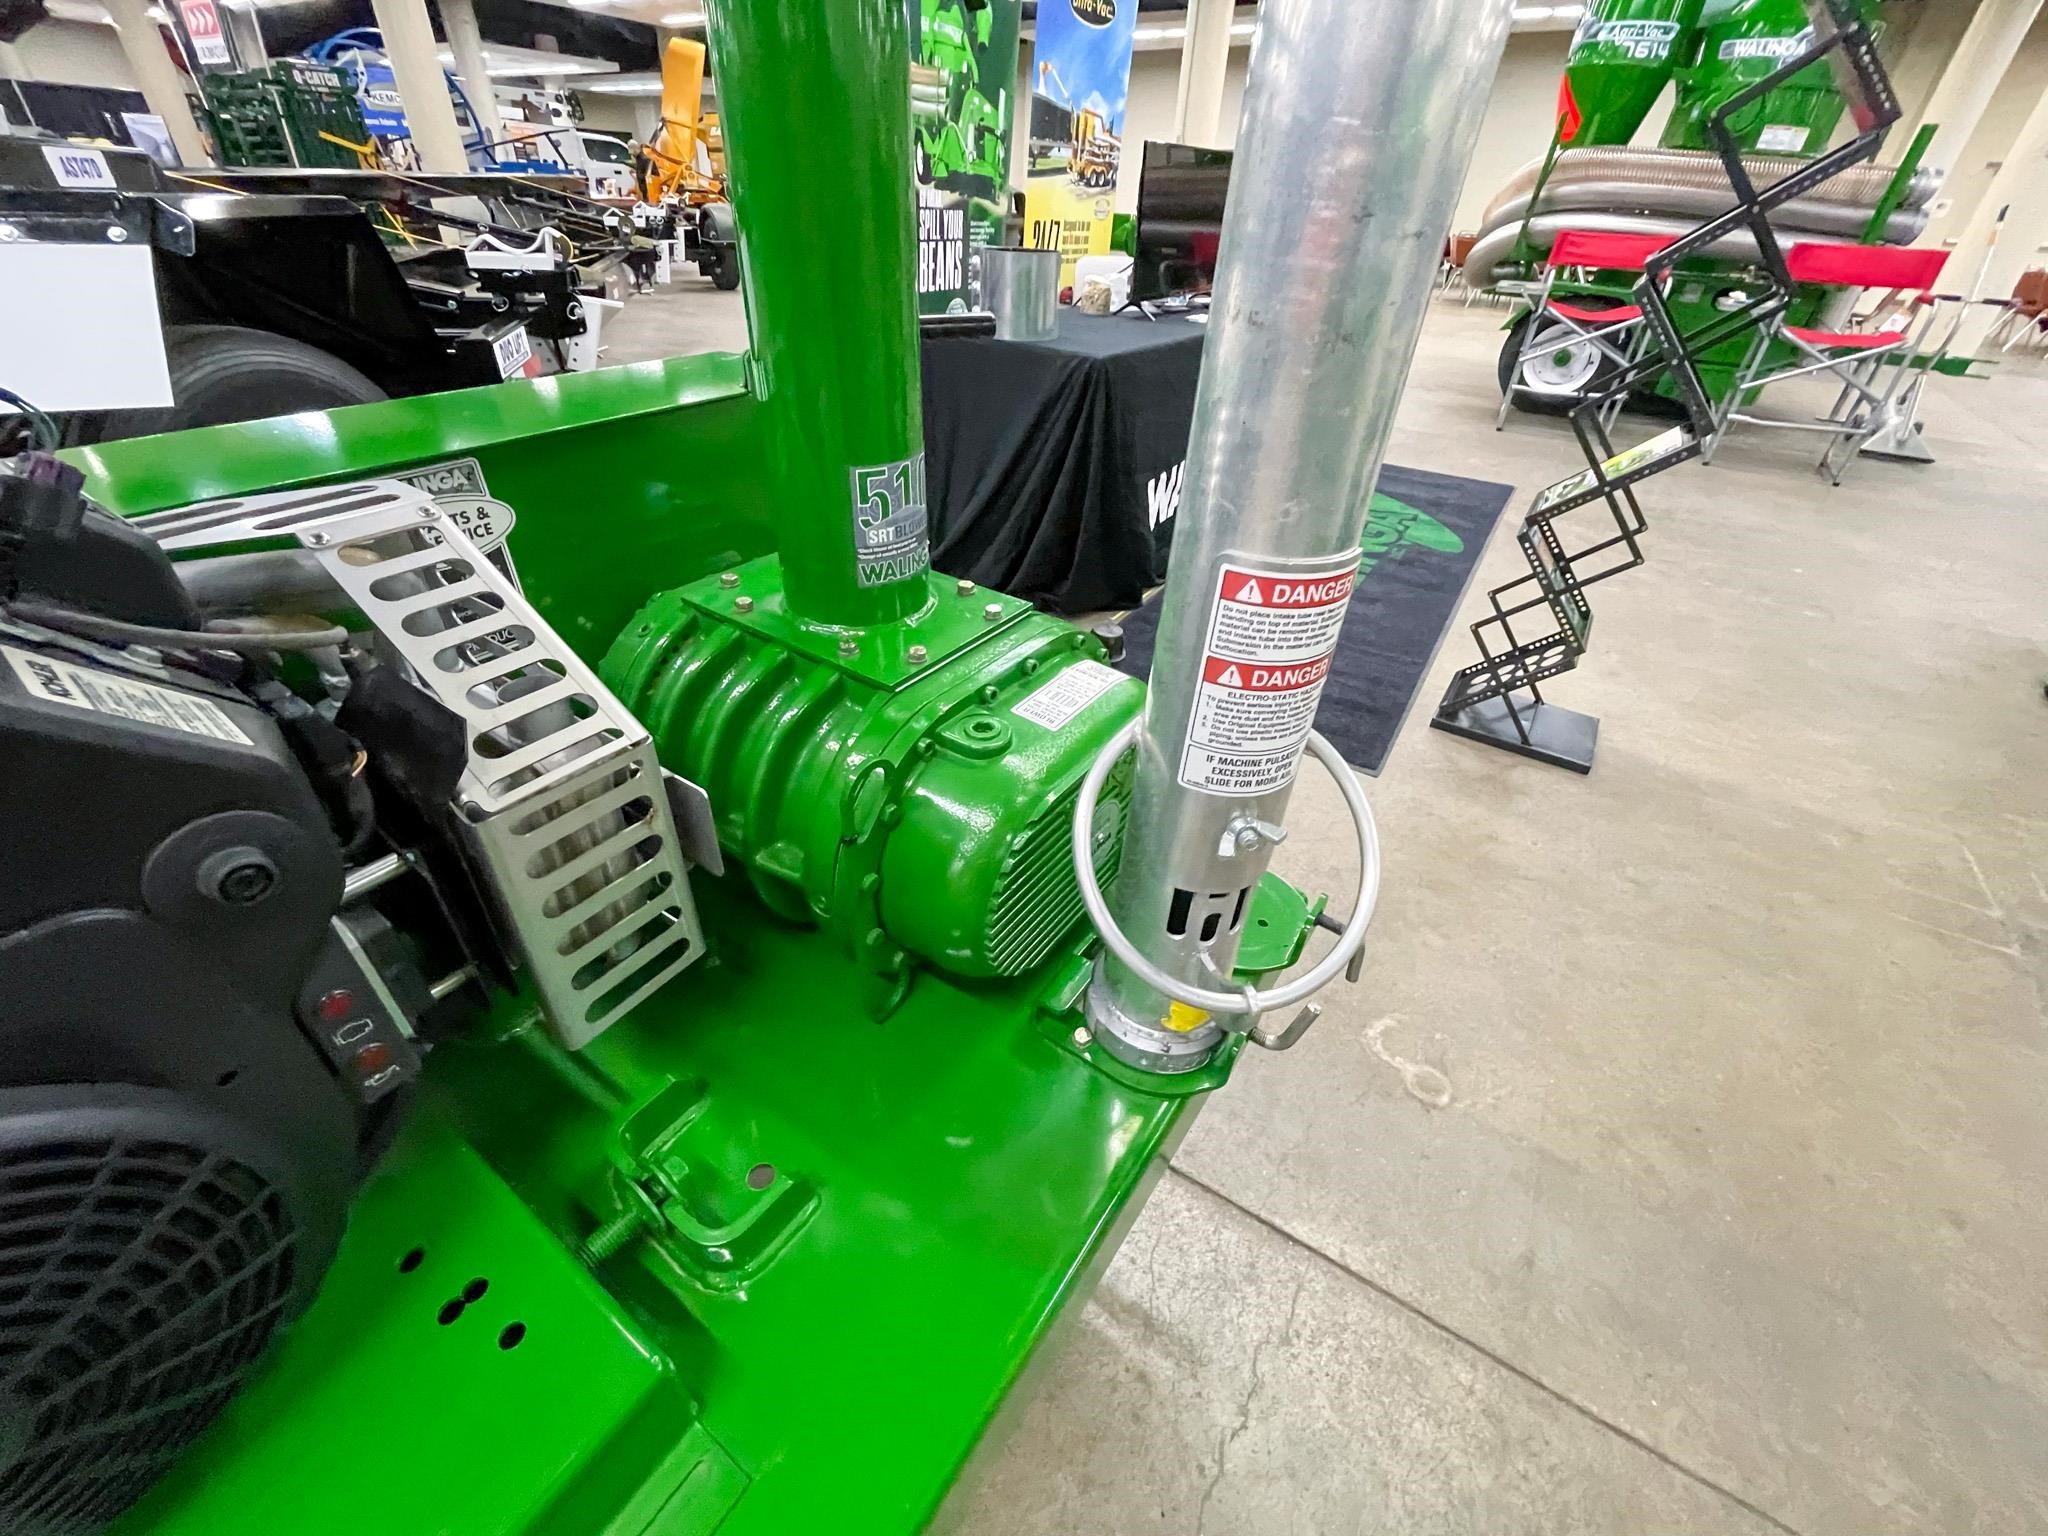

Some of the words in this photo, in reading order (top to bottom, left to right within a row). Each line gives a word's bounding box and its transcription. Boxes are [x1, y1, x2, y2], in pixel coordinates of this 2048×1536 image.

[919, 209, 941, 240] SPILL
[943, 209, 963, 240] YOUR
[919, 241, 963, 292] BEANS
[409, 469, 469, 492] INGA
[476, 506, 490, 520] &
[1272, 575, 1354, 604] DANGER
[1221, 613, 1254, 625] standing
[1249, 610, 1271, 618] place
[1219, 620, 1250, 631] material
[1251, 658, 1328, 687] DANGER
[1227, 691, 1298, 702] ELECTRO-STATIC
[1227, 720, 1256, 728] Original
[1206, 754, 1216, 764] IF
[1217, 757, 1263, 768] MACHINE
[1204, 775, 1231, 788] SLIDE
[1233, 778, 1252, 788] FOR
[1254, 776, 1278, 787] MORE
